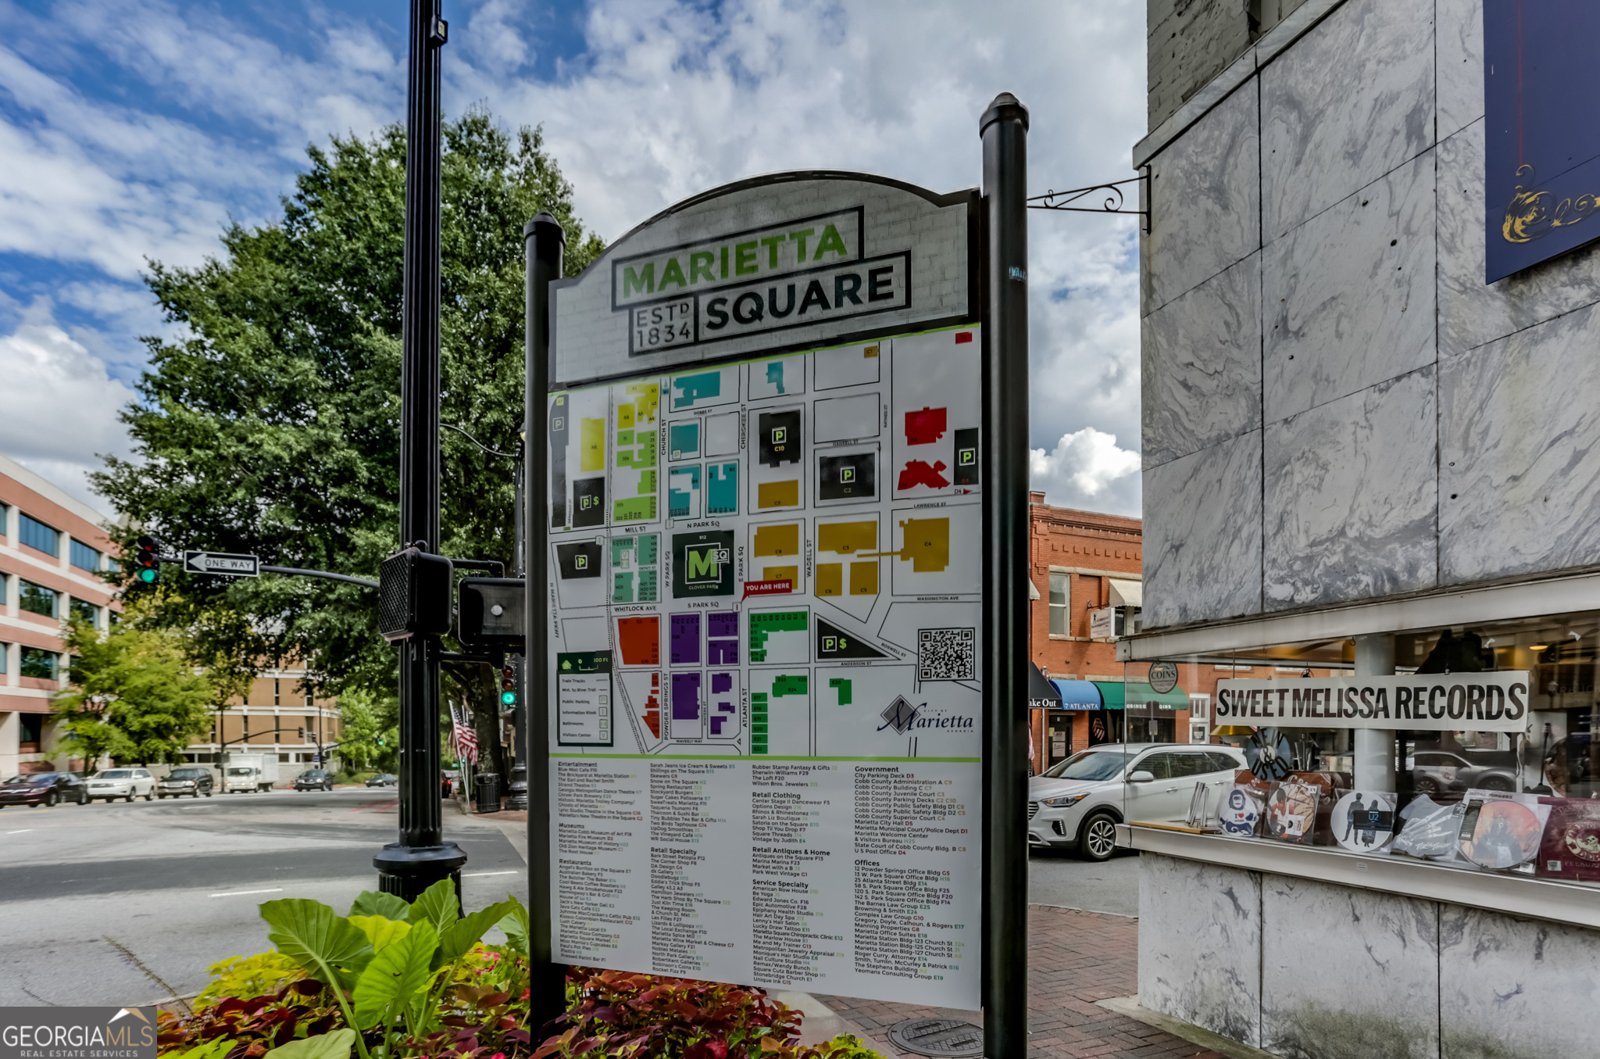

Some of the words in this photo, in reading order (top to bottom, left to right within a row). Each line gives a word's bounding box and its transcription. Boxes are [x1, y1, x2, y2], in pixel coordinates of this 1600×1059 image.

[623, 222, 848, 299] MARIETTA
[706, 265, 895, 330] SQUARE
[637, 322, 691, 348] 1834
[775, 431, 784, 441] P
[738, 546, 744, 556] SQ
[806, 539, 812, 548] ST
[204, 558, 226, 568] ONE
[230, 560, 252, 569] WAY
[665, 551, 670, 560] SQ
[688, 548, 718, 579] M
[1151, 670, 1176, 680] COINS
[1029, 698, 1041, 707] ake
[1042, 698, 1056, 707] Out
[1217, 688, 1290, 718] SWEET
[1292, 687, 1390, 718] MELISSA
[1395, 682, 1527, 720] RECORDS
[877, 700, 973, 732] Marietta
[1252, 755, 1289, 781] USED
